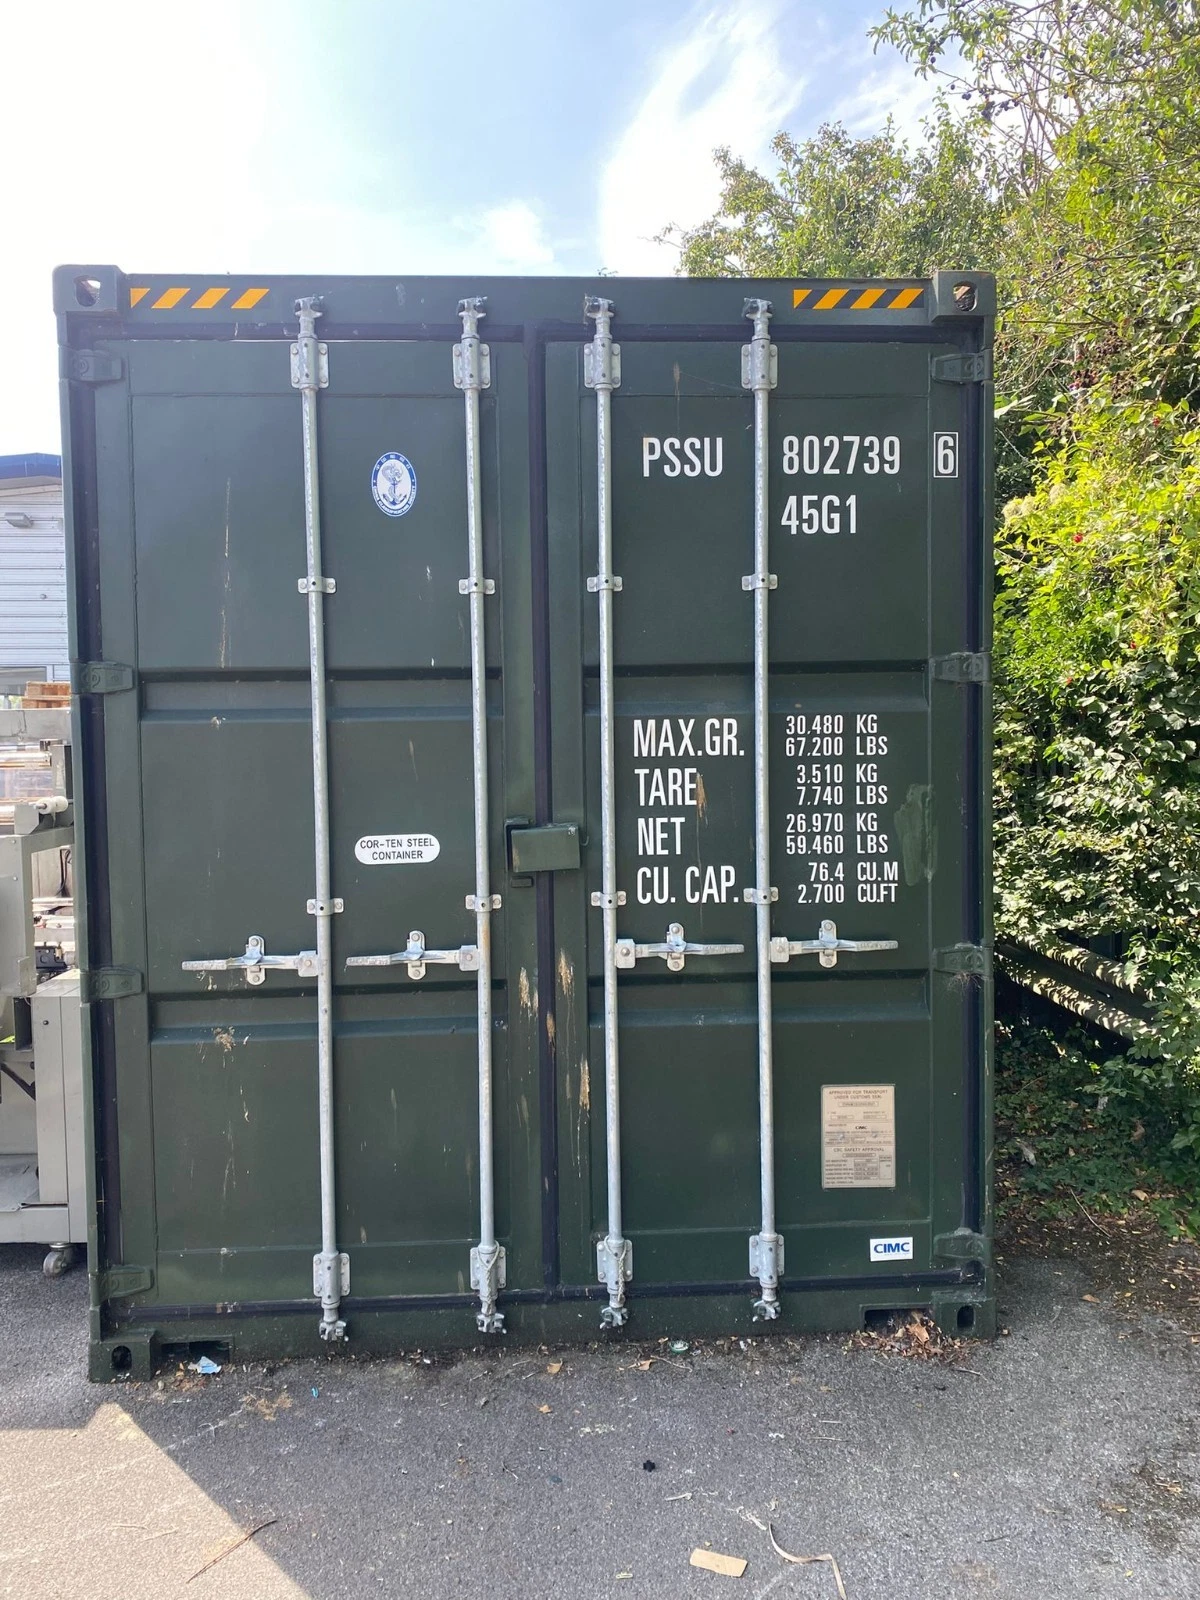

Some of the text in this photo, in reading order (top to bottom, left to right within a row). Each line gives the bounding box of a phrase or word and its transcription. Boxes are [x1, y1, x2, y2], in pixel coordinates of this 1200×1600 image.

[643, 435, 955, 478] PSSU 802739 6
[780, 494, 857, 535] 45G1
[856, 713, 878, 734] KG
[633, 717, 745, 758] MAX.GR.
[855, 735, 888, 756] LBS
[855, 763, 878, 783] KG
[634, 767, 698, 807] TARE
[855, 785, 888, 805] LBS
[856, 812, 878, 832] KG
[360, 838, 434, 849] COR-TEN STEEL
[637, 816, 686, 856] NET
[856, 833, 889, 854] LBS
[371, 850, 423, 860] CONTAINER
[807, 861, 899, 882] 76.4 CU.M
[636, 865, 739, 905] CU. CAP.
[857, 882, 899, 903] CU.FT
[873, 1242, 910, 1254] CIMC
